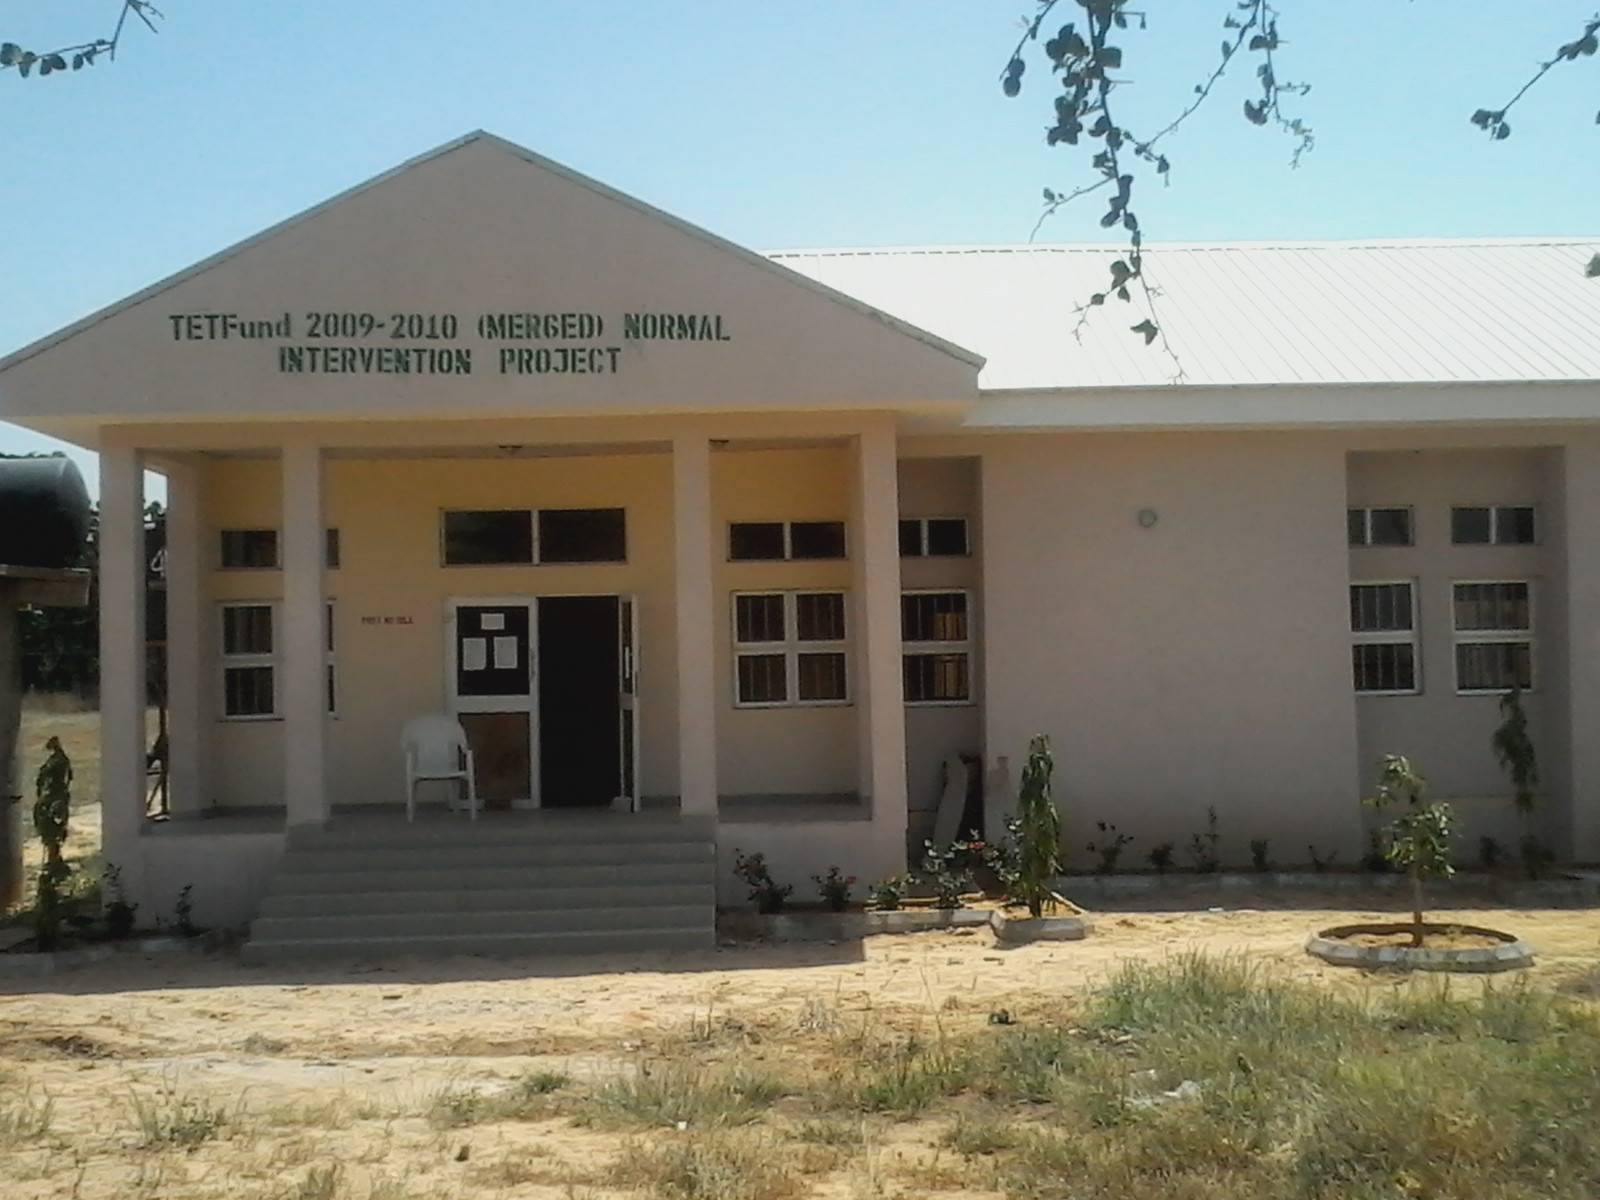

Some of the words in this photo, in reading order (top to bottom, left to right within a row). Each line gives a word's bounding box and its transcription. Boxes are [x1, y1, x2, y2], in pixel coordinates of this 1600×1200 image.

[168, 313, 290, 340] TETFund
[306, 313, 456, 339] 2009-2010
[478, 313, 603, 339] (MERGED)
[624, 313, 731, 340] NORMAL
[279, 348, 471, 374] INTERVENTION
[500, 348, 621, 374] PROJECT
